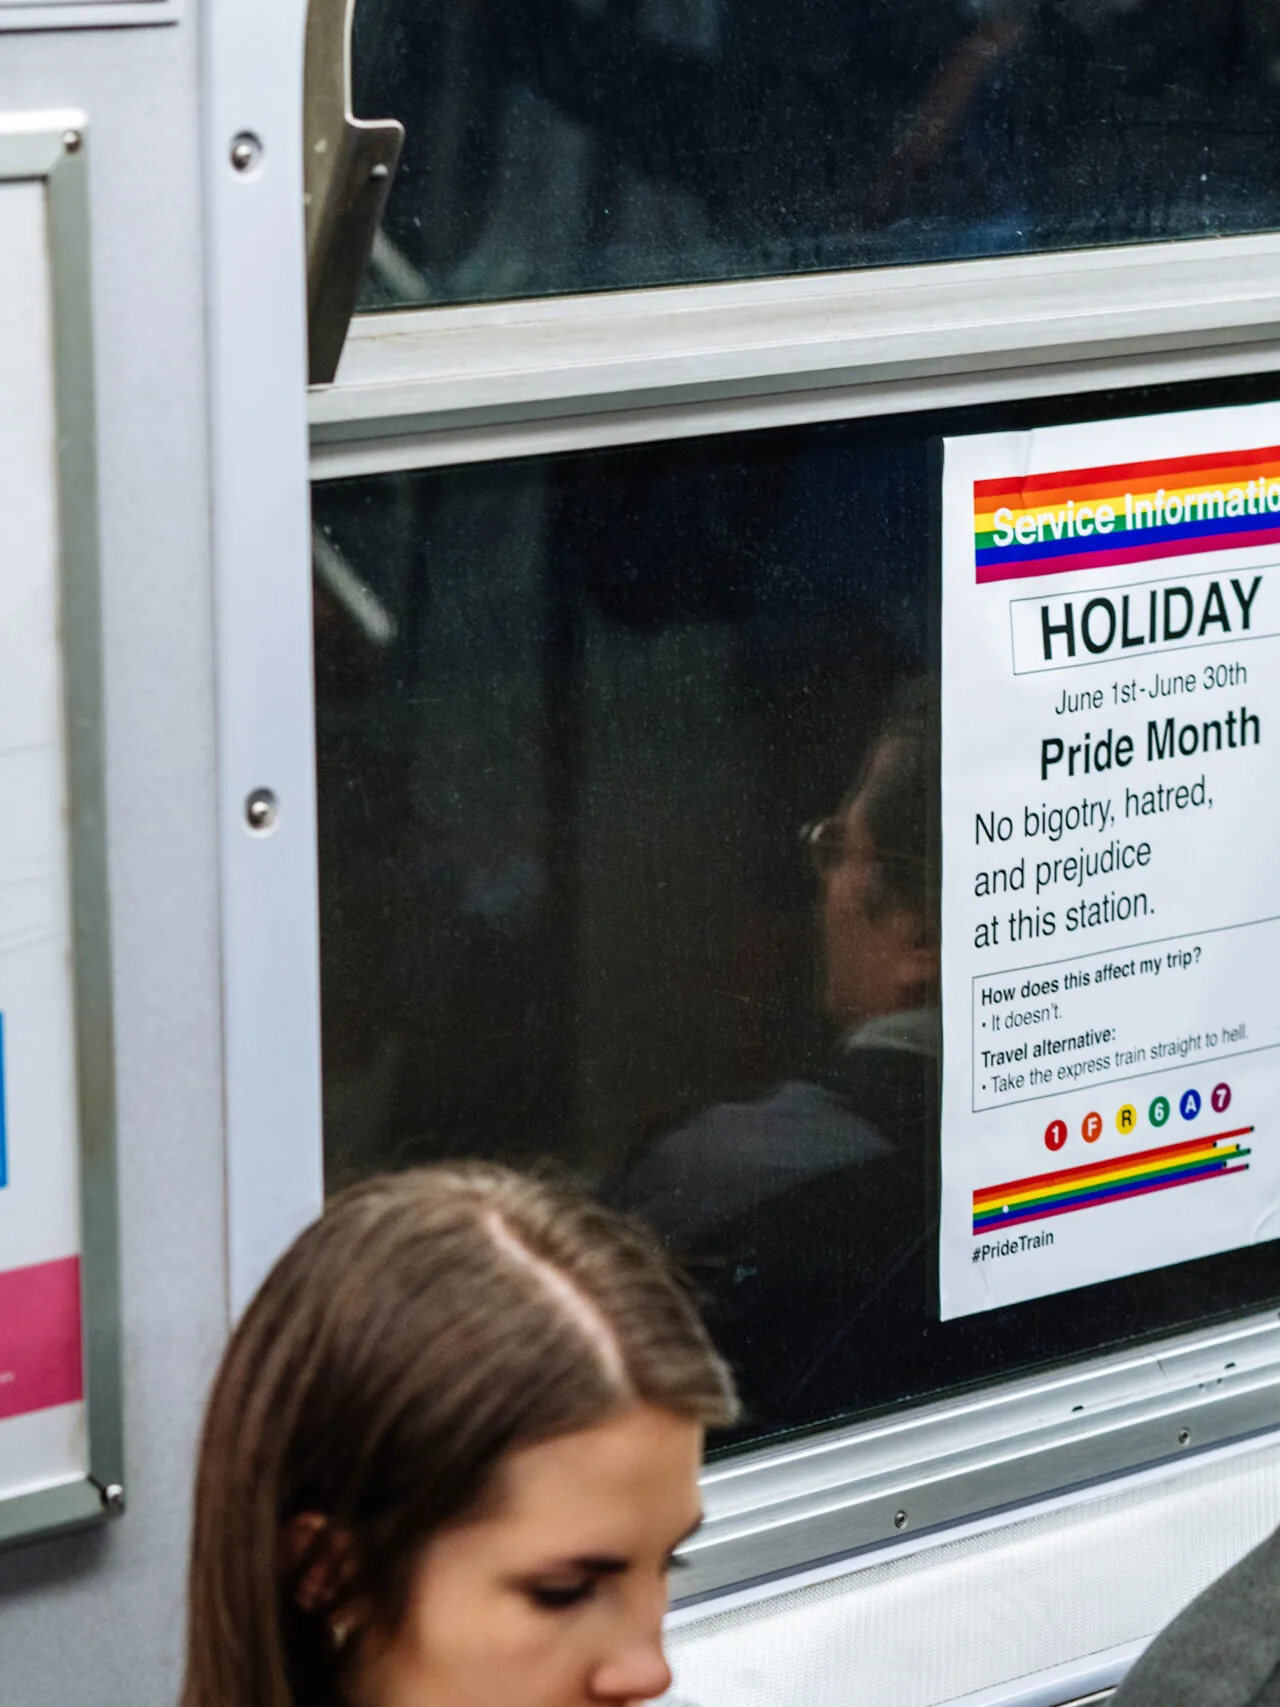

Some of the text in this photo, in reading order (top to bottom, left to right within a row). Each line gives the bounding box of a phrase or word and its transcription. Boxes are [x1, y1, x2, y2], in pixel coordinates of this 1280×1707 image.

[993, 501, 1115, 546] Service
[1041, 576, 1262, 661] HOLIDAY
[1054, 689, 1104, 716] June
[1203, 662, 1247, 690] 30th
[1040, 706, 1261, 781] Pride Month
[975, 774, 1213, 846] No bigotry, hatred,
[974, 839, 1152, 898] and prejudice
[973, 890, 1155, 949] at this station.
[981, 946, 1202, 1007] How does this affect my trip?
[980, 1028, 1117, 1069] Travel alternative:
[991, 1014, 1001, 1031] It
[990, 1023, 1249, 1093] Take the express train straight to hell.
[1052, 1088, 1227, 1144] 1 F R 6 A 7
[971, 1230, 1054, 1264] #PrideTrain
